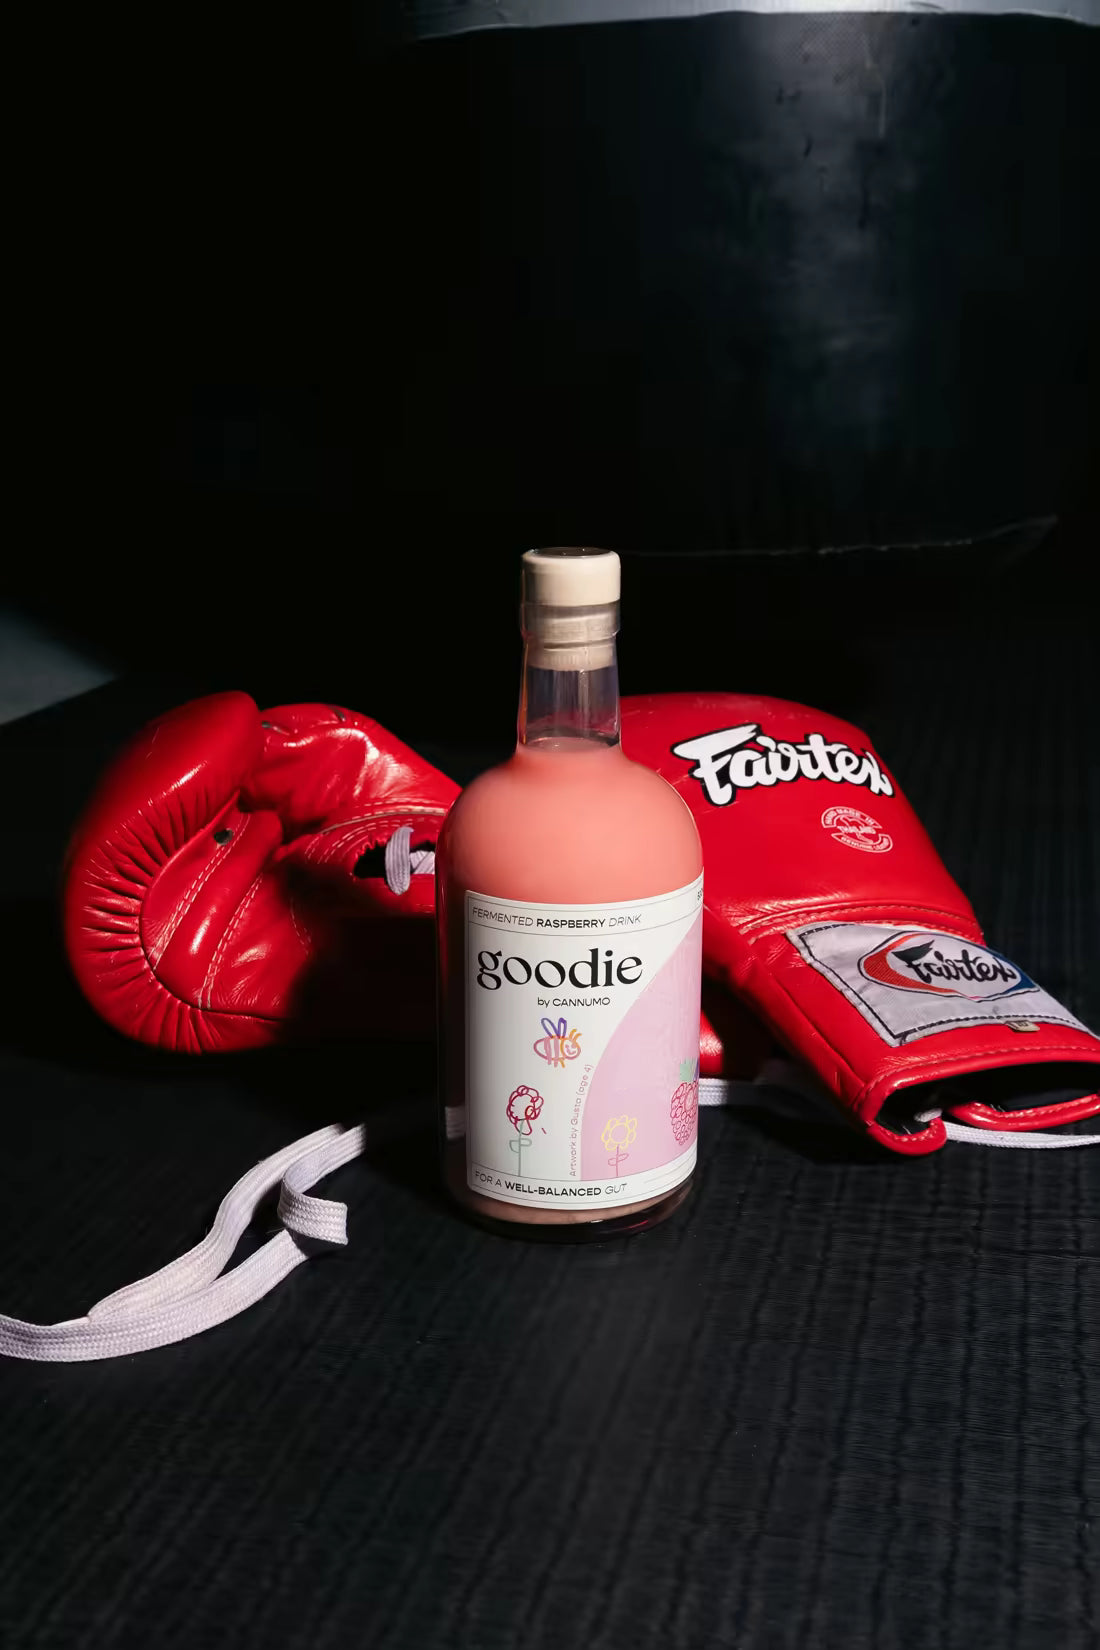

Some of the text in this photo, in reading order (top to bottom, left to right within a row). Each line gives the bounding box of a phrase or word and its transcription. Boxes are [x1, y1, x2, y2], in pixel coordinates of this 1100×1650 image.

[671, 722, 895, 807] Fairtex
[472, 907, 642, 929] FERMENTED RASPBERRY DRINK
[476, 948, 643, 991] goodie
[891, 939, 1017, 984] Fairtex
[537, 997, 611, 1008] by CANNUMO
[570, 1128, 579, 1139] by
[569, 1141, 577, 1177] Artwork
[475, 1171, 627, 1197] FOR A WELL-BALANCED GUT
